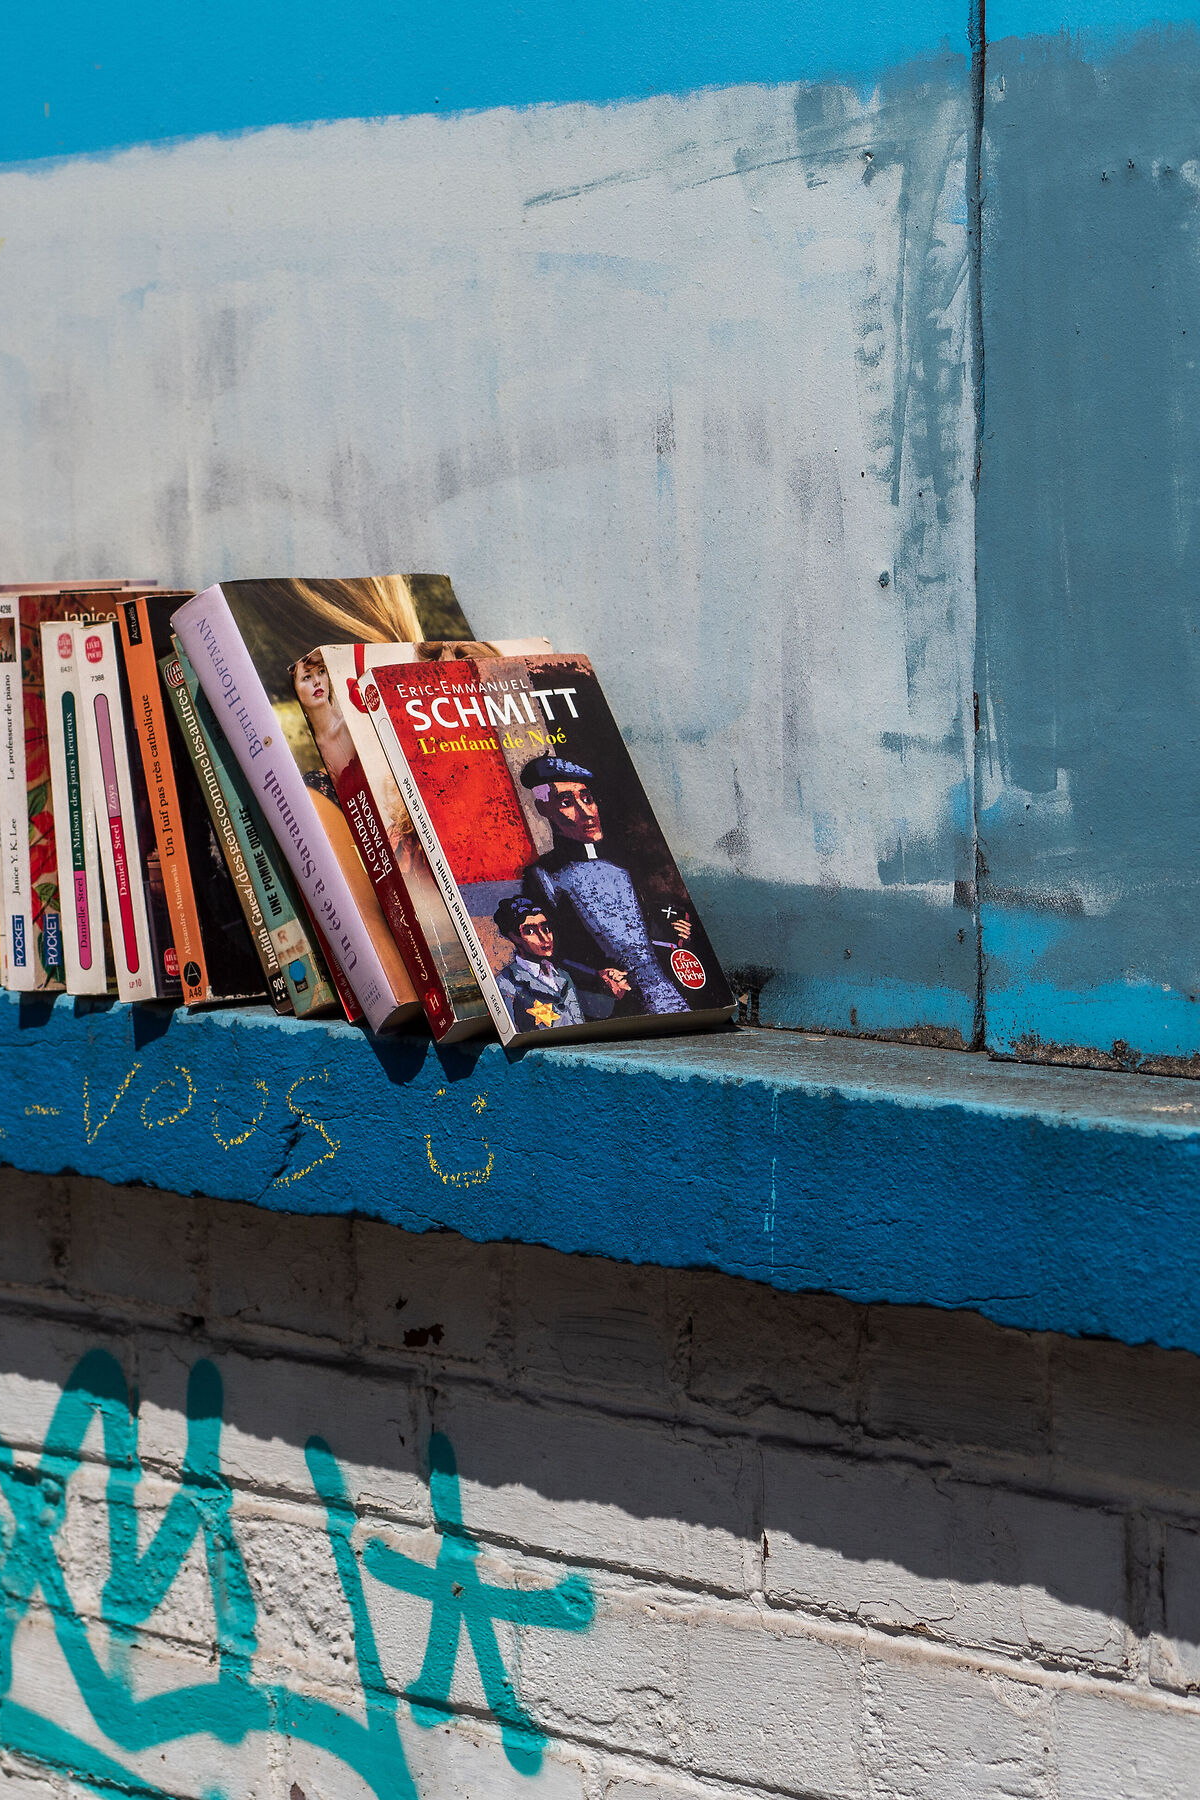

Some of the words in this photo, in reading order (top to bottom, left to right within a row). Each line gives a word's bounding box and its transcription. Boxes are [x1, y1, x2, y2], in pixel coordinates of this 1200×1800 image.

[130, 605, 139, 640] Actuels
[196, 617, 241, 709] HOFFMAN
[3, 674, 13, 704] piano
[4, 705, 12, 717] de
[141, 693, 159, 761] catholique
[175, 687, 201, 733] autres
[404, 687, 581, 732] SCHMITT
[4, 717, 14, 769] professeur
[66, 711, 76, 756] heureux
[236, 707, 264, 760] BETH
[417, 733, 499, 757] L'enfant
[502, 731, 524, 752] de
[527, 726, 567, 748] Noé
[7, 770, 15, 780] Le
[68, 760, 80, 787] jours
[152, 762, 164, 785] très
[201, 758, 227, 817] comme
[401, 776, 416, 802] Noé
[69, 790, 79, 806] des
[108, 783, 118, 811] Zoya
[157, 786, 168, 807] pas
[412, 801, 424, 818] de
[9, 818, 17, 836] Lee
[71, 807, 81, 849] Maison
[111, 823, 121, 849] Steel
[160, 808, 171, 836] Juif
[220, 818, 240, 853] gens
[238, 804, 262, 850] OUBLIÉE
[263, 767, 317, 879] Savannah
[346, 797, 376, 864] CITADELLE
[356, 789, 386, 857] PASSIONS
[420, 817, 437, 855] L'enfant
[10, 840, 18, 852] K.
[11, 853, 19, 864] Y.
[73, 850, 82, 866] La
[164, 836, 175, 858] Un
[12, 866, 21, 896] Janice
[114, 851, 128, 896] Danielle
[253, 849, 274, 893] POMME
[369, 864, 384, 885] LA
[378, 855, 393, 877] DES
[435, 857, 457, 904] Schmitt
[77, 877, 86, 902] Steel
[172, 866, 185, 914] Minkowski
[265, 892, 284, 917] UNE
[313, 878, 326, 898] à
[78, 906, 89, 949] Danielle
[319, 897, 341, 932] été
[15, 915, 25, 967] POCKET
[46, 915, 58, 965] POCKET
[178, 916, 192, 958] Alexandre
[257, 927, 279, 970] Judith
[339, 934, 359, 973] Un
[405, 926, 429, 982] Catherine
[449, 901, 489, 983] Eric-Emmanuel
[673, 957, 700, 970] Livre
[676, 969, 705, 982] Poche
